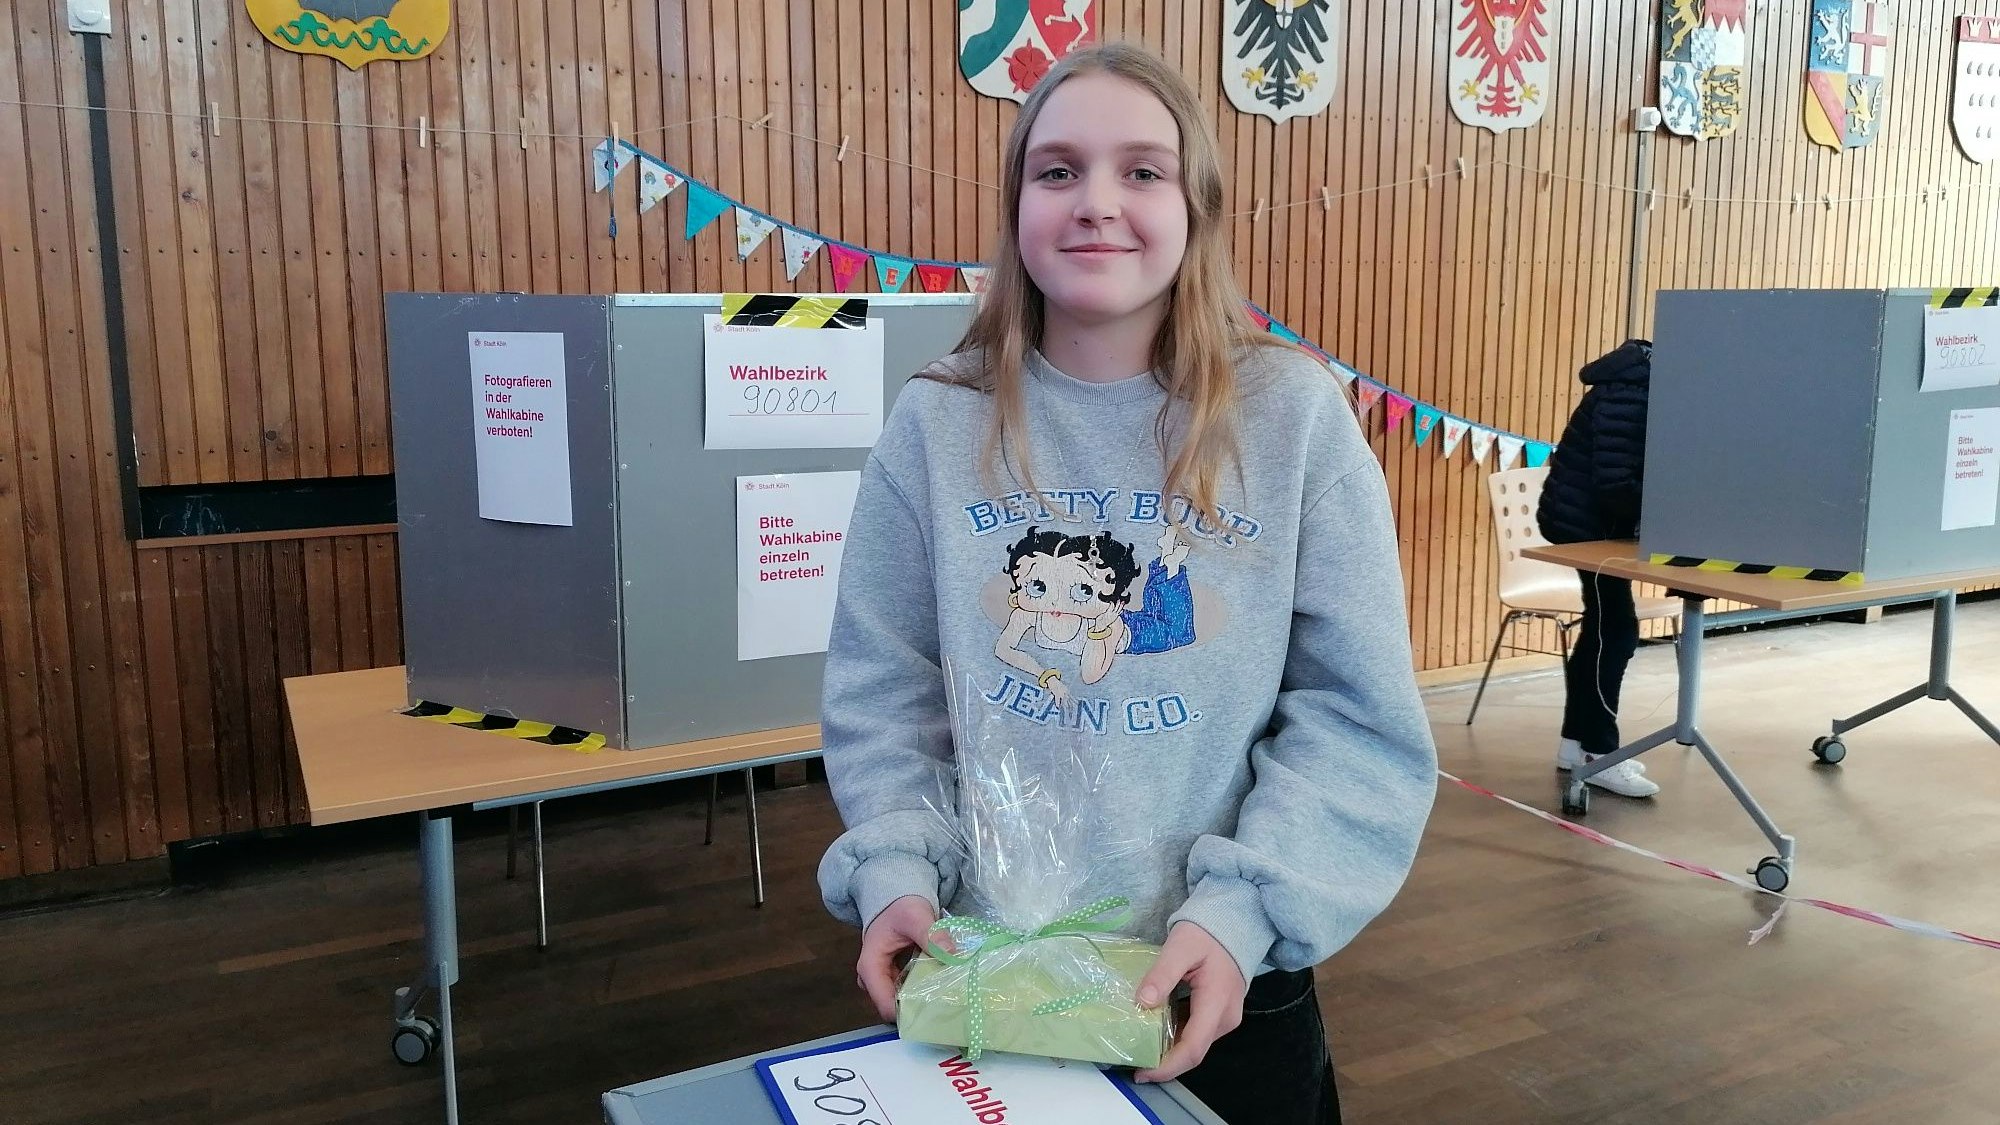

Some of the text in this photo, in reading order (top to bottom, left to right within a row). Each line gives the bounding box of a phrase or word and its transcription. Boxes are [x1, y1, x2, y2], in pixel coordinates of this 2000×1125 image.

[1935, 333, 1979, 346] Wahlbezirk
[1940, 344, 1986, 369] 90802
[729, 365, 828, 381] Wahlbezirk
[484, 374, 552, 389] Fotografieren
[485, 390, 512, 403] in der
[743, 385, 837, 415] 90801
[486, 407, 544, 421] Wahlkabine
[486, 425, 533, 438] verboten!
[1958, 436, 1974, 445] Bitte
[963, 487, 1120, 537] BETTY
[759, 516, 794, 529] Bitte
[759, 530, 843, 546] Wahlkabine
[759, 549, 810, 564] einzeln
[760, 565, 824, 582] betreten!
[984, 672, 1203, 735] JEAN CO.
[938, 1054, 1008, 1125] Wahlb
